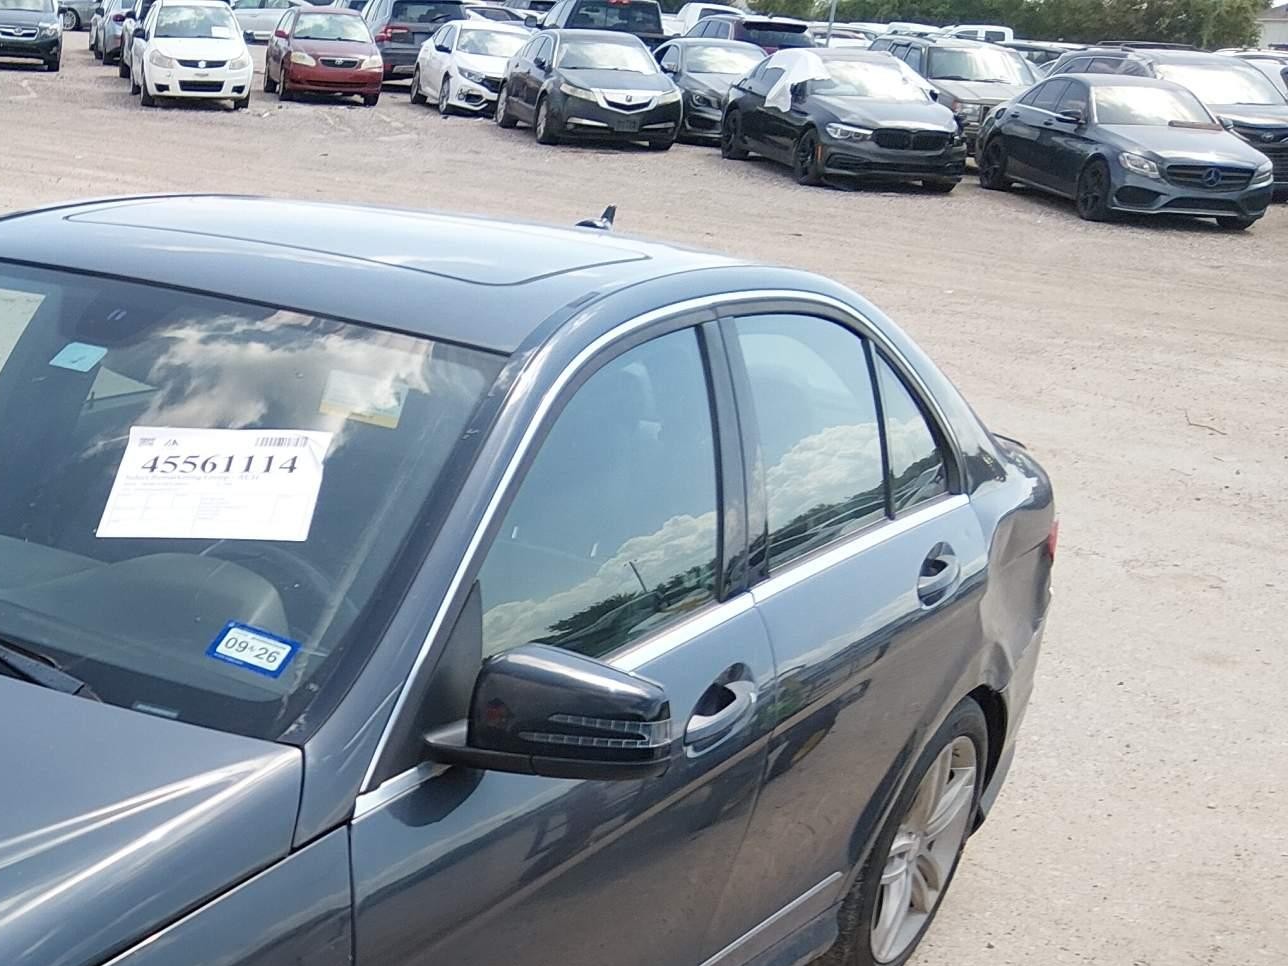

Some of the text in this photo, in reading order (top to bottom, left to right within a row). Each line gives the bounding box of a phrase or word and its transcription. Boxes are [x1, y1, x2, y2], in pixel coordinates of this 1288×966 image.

[141, 454, 298, 473] 45561114
[225, 637, 281, 664] 09 26
